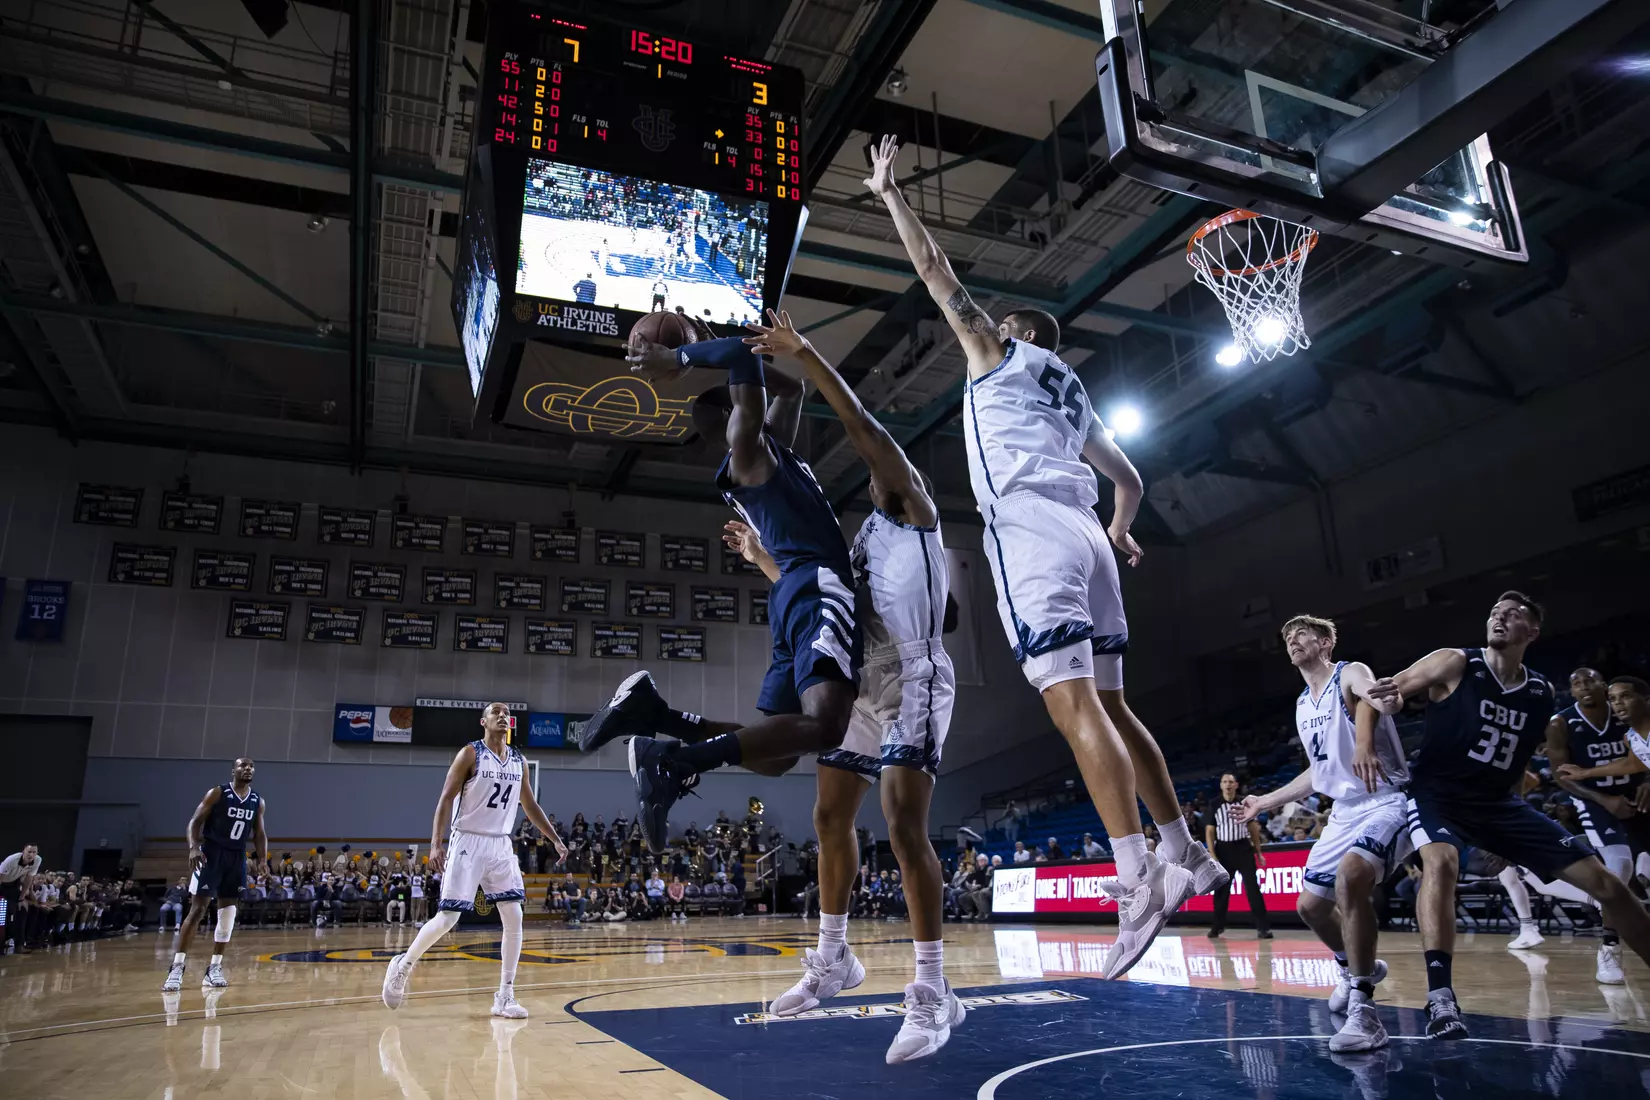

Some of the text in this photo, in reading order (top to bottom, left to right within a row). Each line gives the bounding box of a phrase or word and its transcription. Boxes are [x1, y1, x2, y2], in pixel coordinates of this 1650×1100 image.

[563, 37, 580, 63] 7
[631, 29, 693, 64] 15:20
[501, 59, 562, 84] 55 0 0
[504, 51, 563, 72] PLY PTS FL
[657, 63, 662, 79] 1
[505, 77, 561, 101] 11 2 0
[752, 81, 768, 105] 3
[498, 94, 559, 118] 42 5 0
[747, 106, 760, 116] PLY
[502, 111, 558, 135] 14 0 1
[572, 114, 609, 129] FLS TOL
[583, 125, 606, 141] 1 4
[745, 113, 798, 137] 35 0 1
[495, 128, 557, 153] 24 0 0
[745, 129, 799, 153] 33 0 0
[714, 152, 736, 170] 1 4
[754, 146, 799, 169] 0 2 0
[750, 163, 799, 185] 15 1 0
[745, 178, 800, 201] 31 0 0
[537, 313, 620, 336] ATHLETICS
[538, 303, 616, 325] UC IRVINE
[29, 603, 57, 620] 12
[338, 710, 373, 721] PEPSI
[419, 699, 445, 707] BREN
[450, 701, 486, 710] EVENTS
[1479, 699, 1528, 731] CBU
[1467, 724, 1519, 770] 33
[1587, 740, 1626, 758] CBU
[482, 770, 521, 782] UC IRVINE
[487, 782, 513, 810] 24
[227, 806, 254, 821] CBU
[230, 820, 246, 841] 0
[1035, 878, 1057, 900] DINE
[1057, 877, 1069, 900] IN
[1255, 866, 1306, 895] CATER
